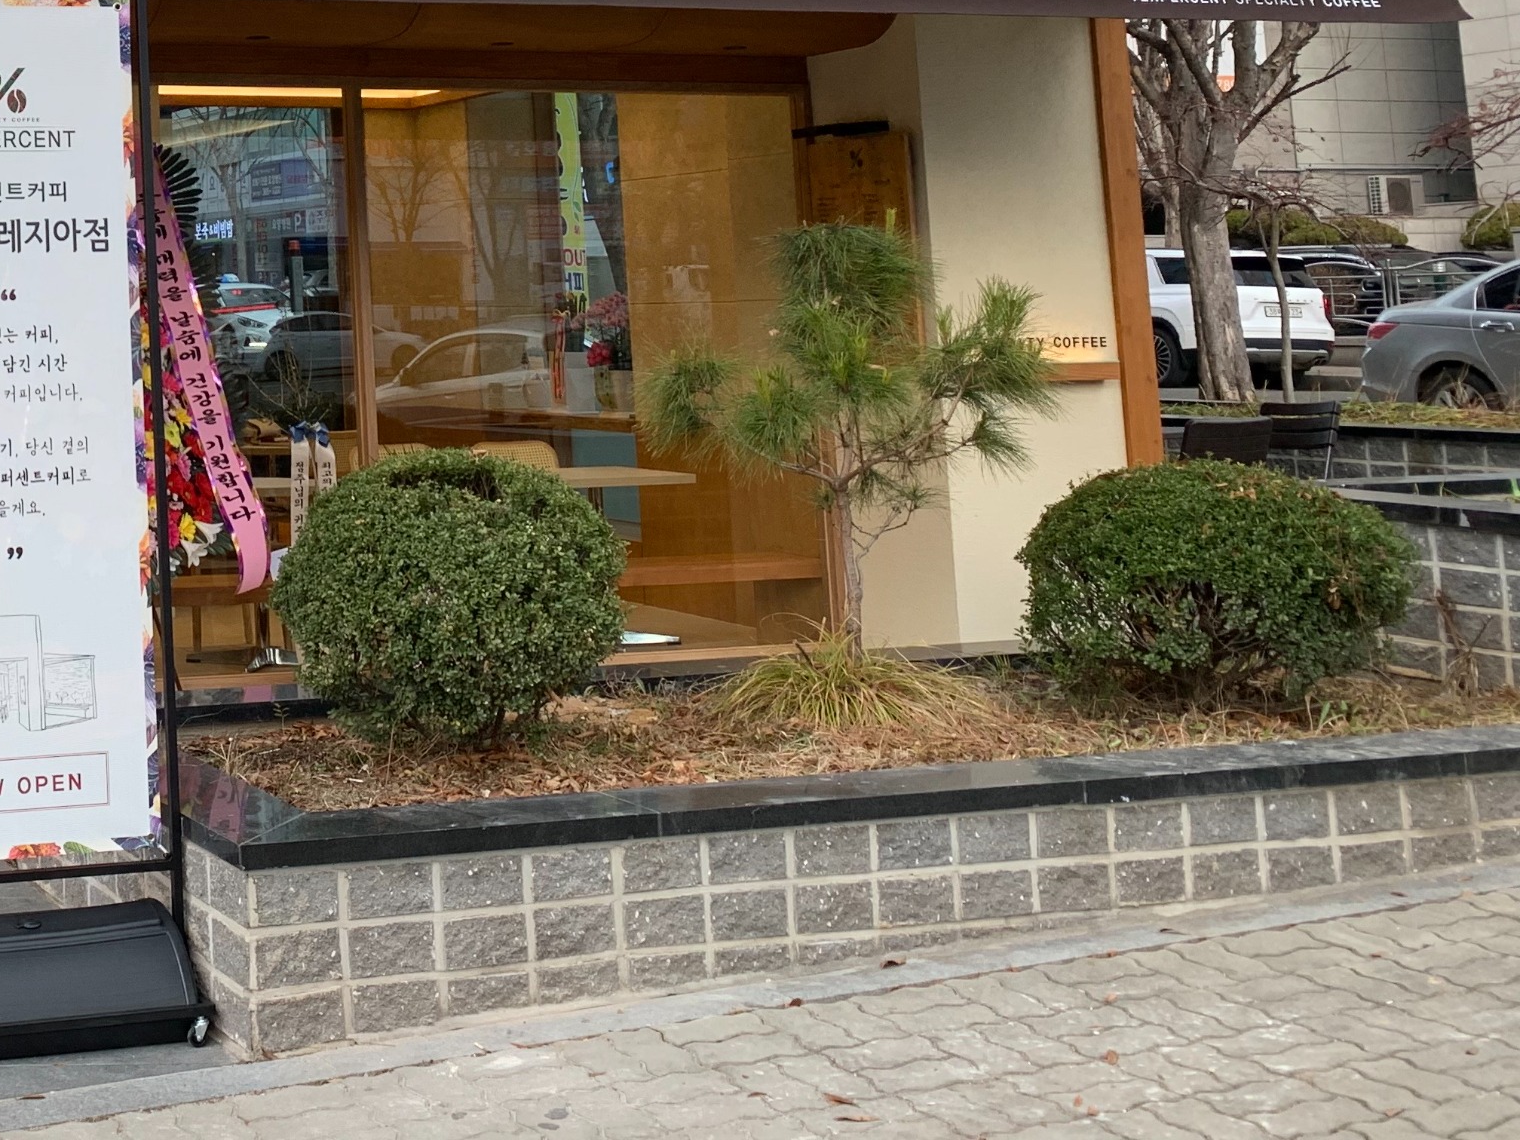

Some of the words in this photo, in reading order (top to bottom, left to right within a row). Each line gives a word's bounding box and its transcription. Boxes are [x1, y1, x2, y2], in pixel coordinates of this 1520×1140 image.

[25, 324, 59, 345] 커피,
[1053, 336, 1108, 349] COFFEE
[2, 354, 31, 374] 담긴
[37, 353, 68, 374] 시간
[3, 383, 84, 403] 커피입니다.
[170, 311, 202, 363] 날숨에
[186, 373, 222, 425] 건강을
[206, 435, 256, 522] 기원합니다
[25, 437, 54, 457] 당신
[62, 436, 90, 455] 곁의
[17, 772, 83, 795] OPEN
